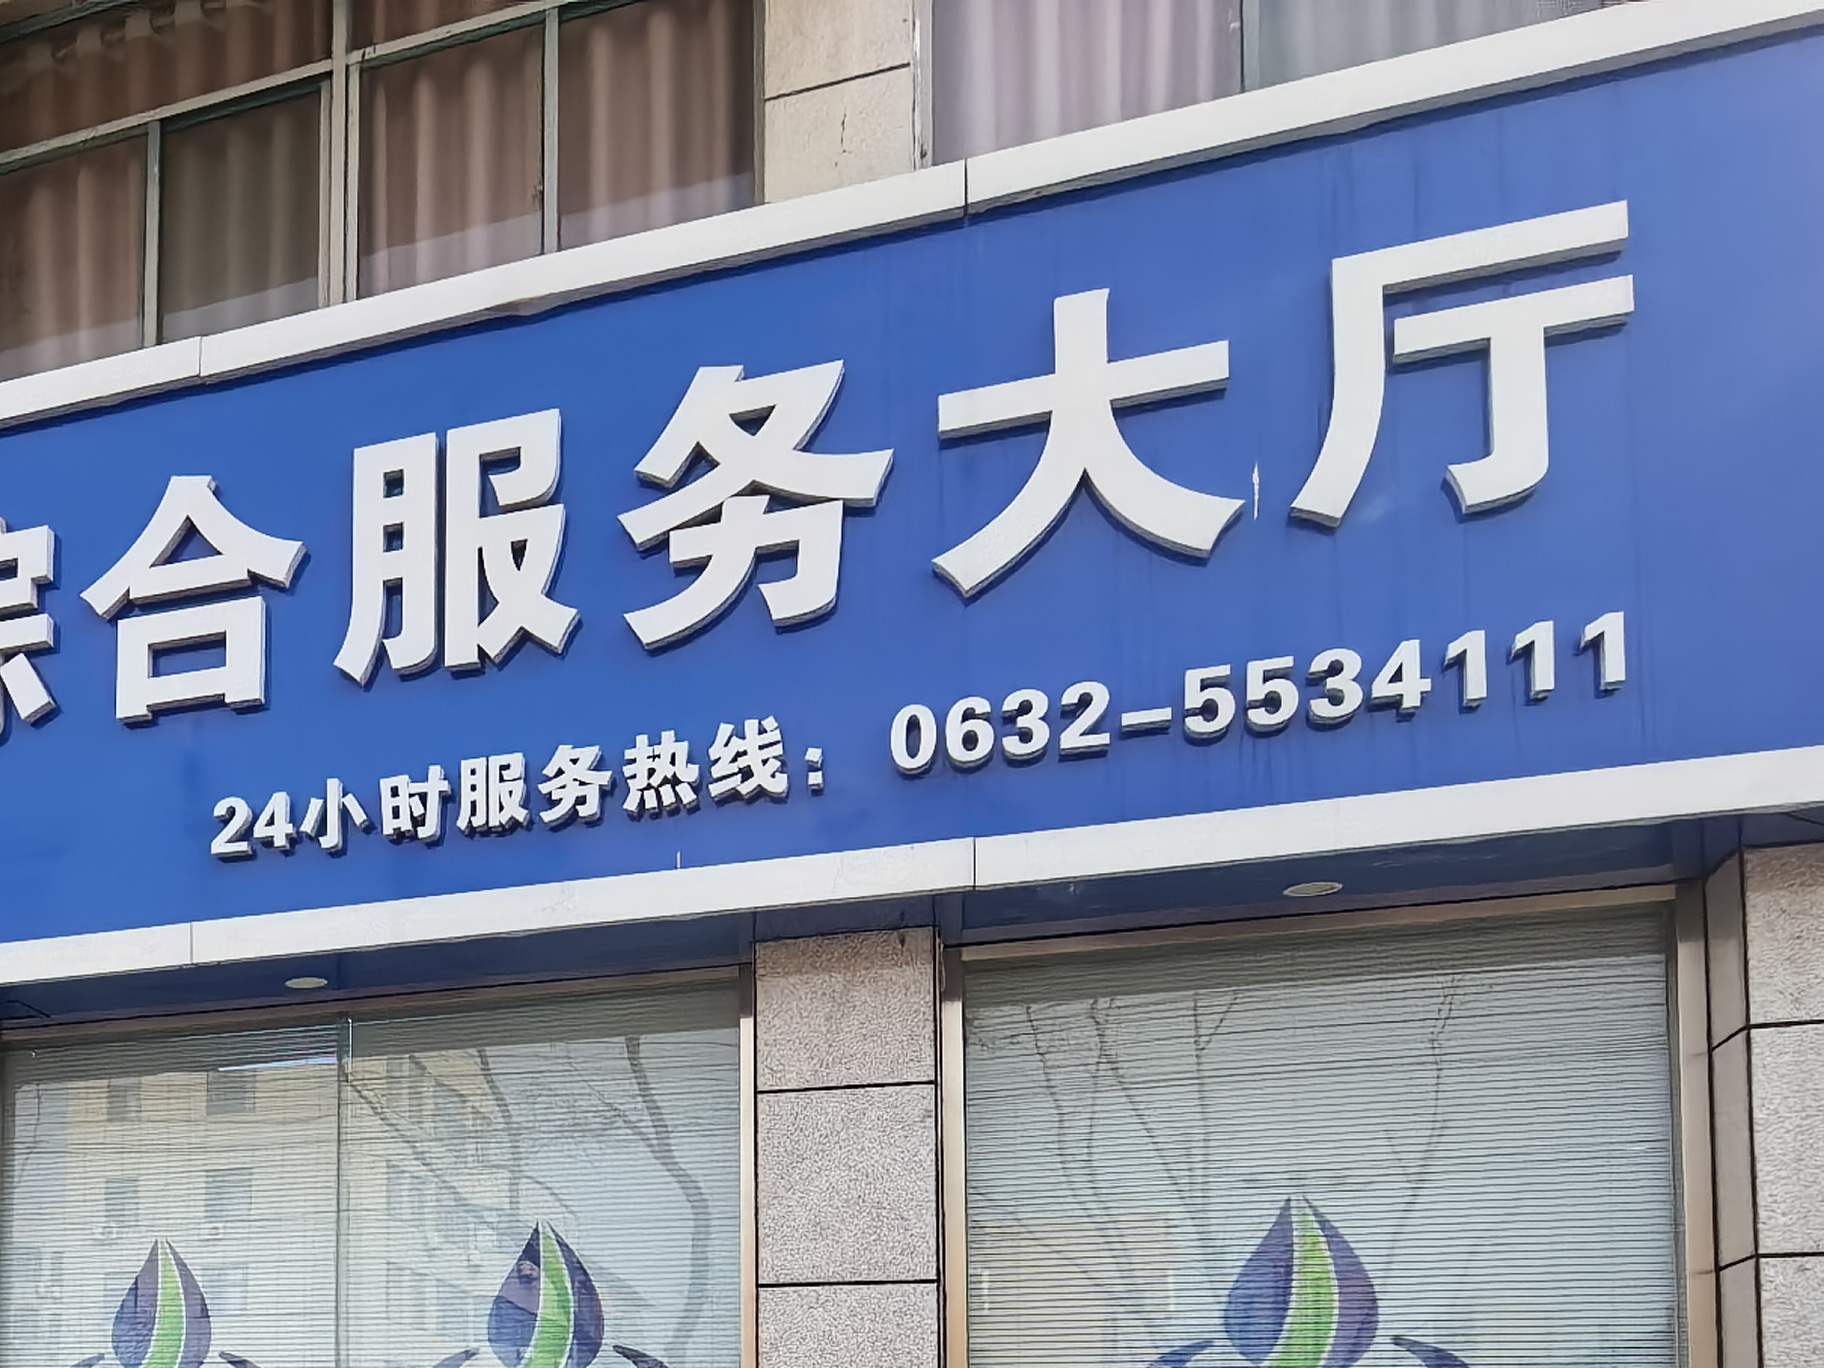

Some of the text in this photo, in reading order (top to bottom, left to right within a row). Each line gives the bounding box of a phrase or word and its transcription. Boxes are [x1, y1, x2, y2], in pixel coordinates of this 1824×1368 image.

[210, 611, 1631, 858] 24小时服务热线： 0632-5534111
